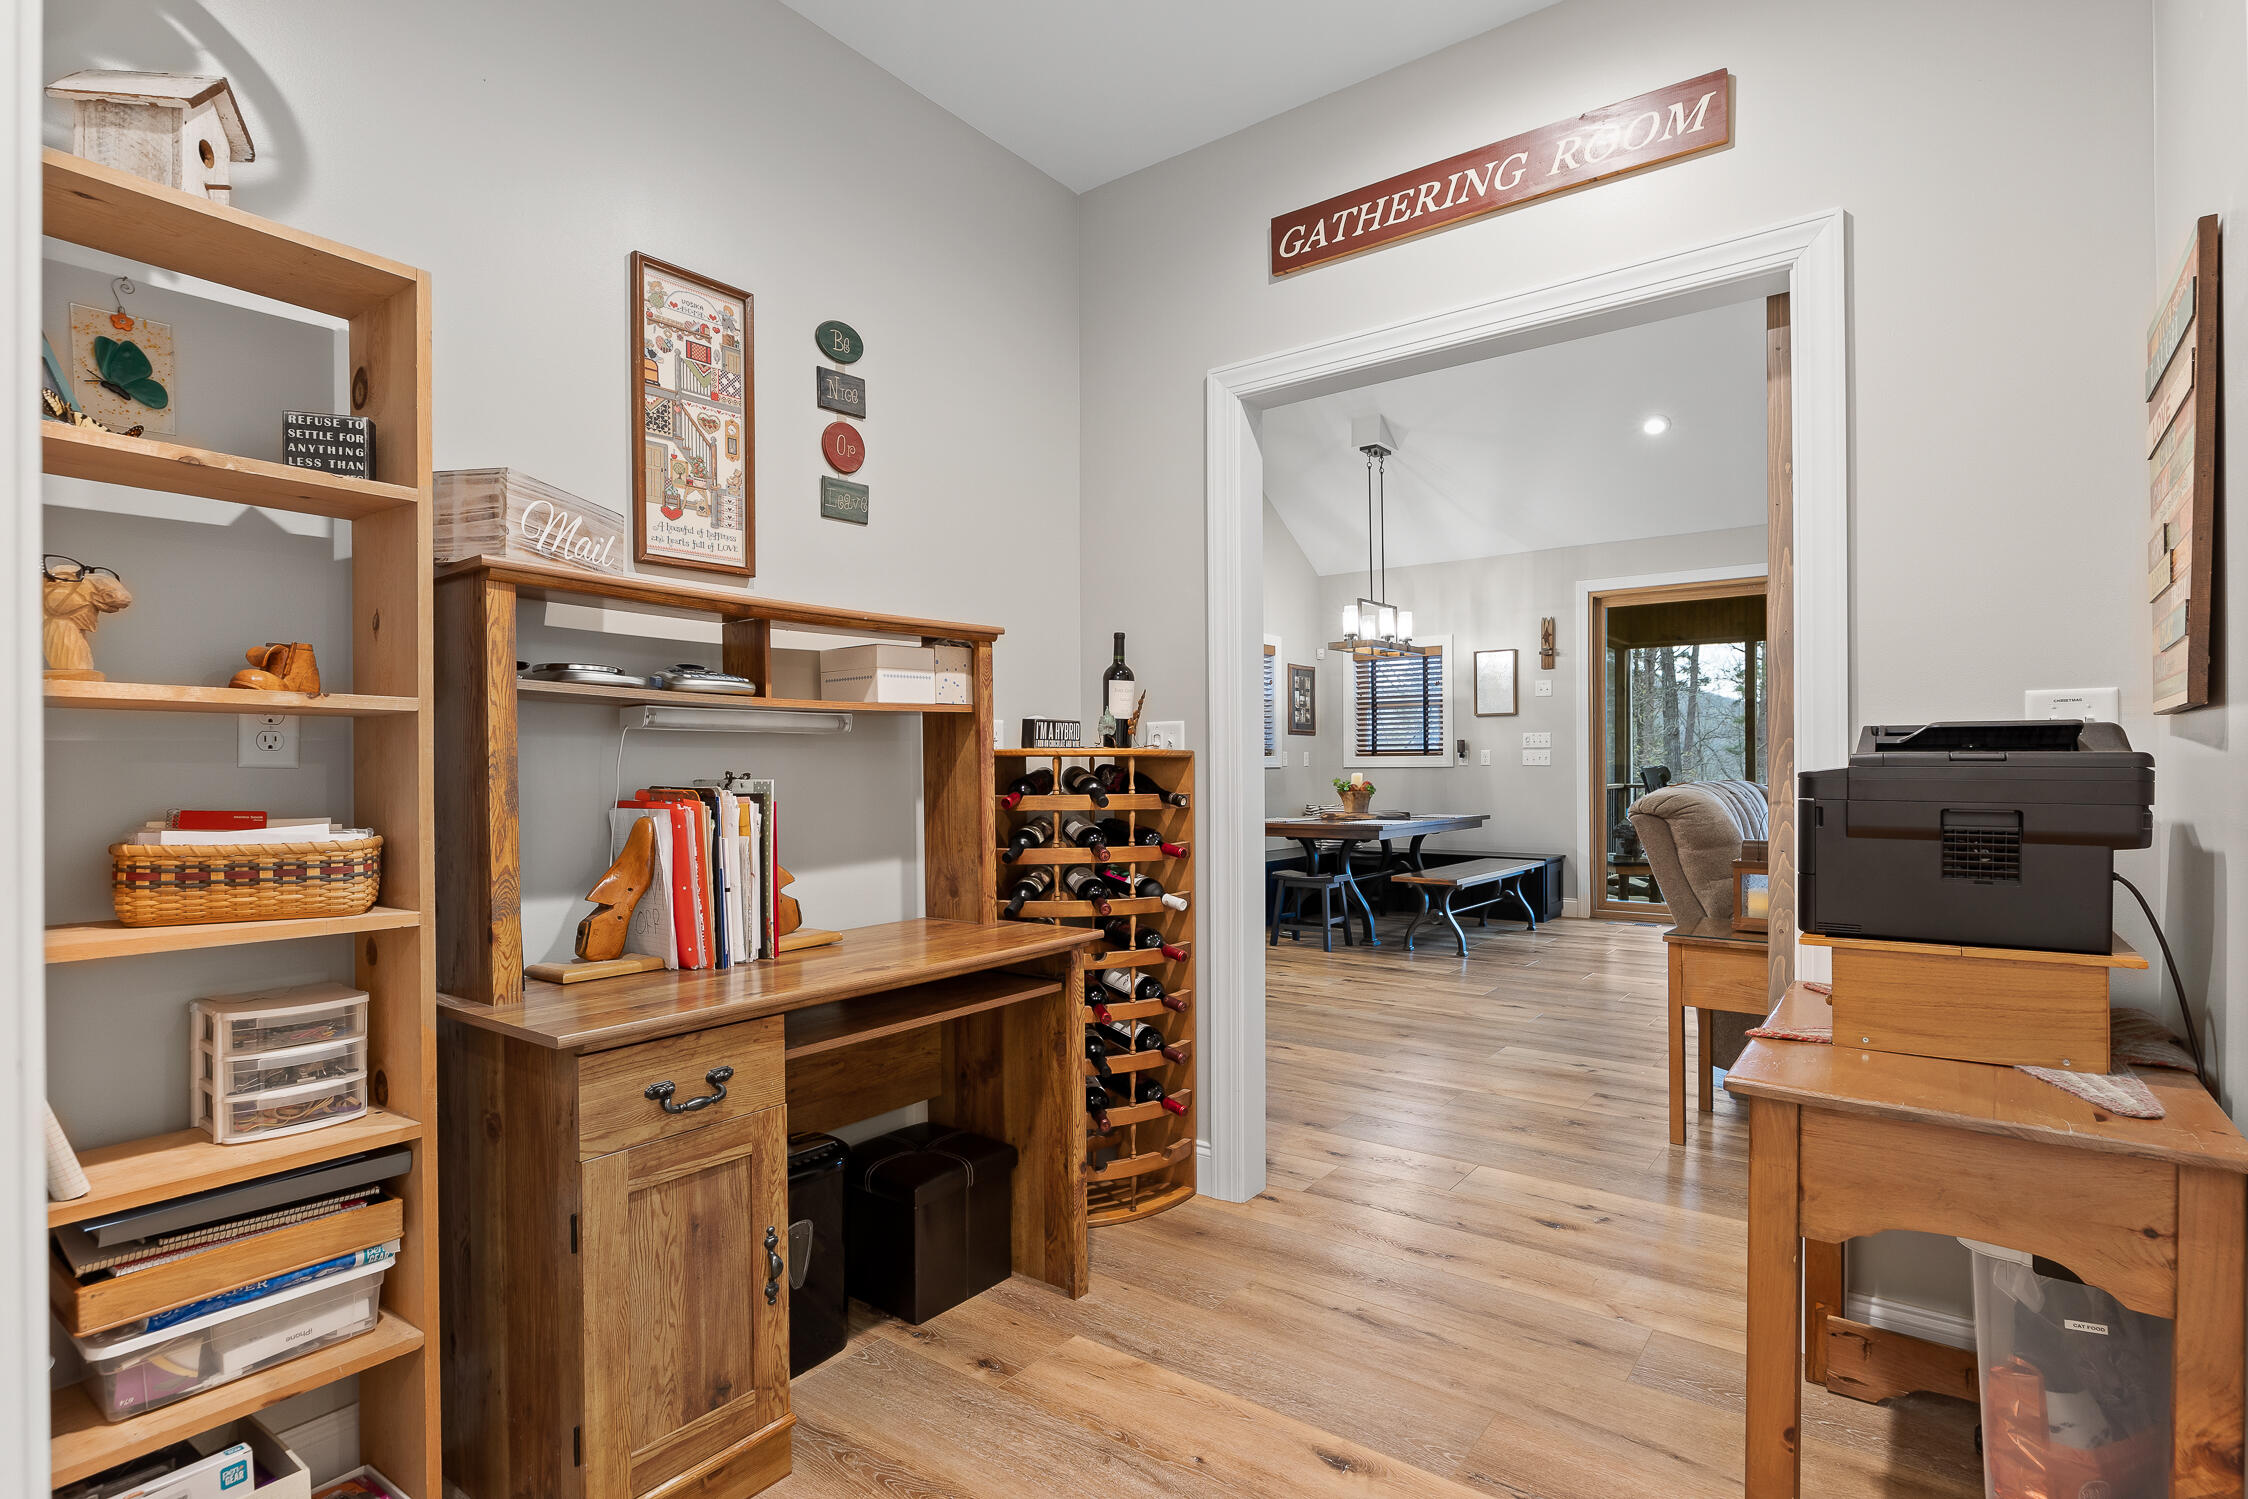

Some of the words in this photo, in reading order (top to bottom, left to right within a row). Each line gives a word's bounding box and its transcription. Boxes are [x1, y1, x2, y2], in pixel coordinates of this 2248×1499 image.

[1279, 151, 1529, 258] GATHERING
[1546, 91, 1717, 176] ROOM
[830, 329, 850, 353] Be
[287, 414, 341, 428] REFUSE
[346, 419, 364, 430] TO
[2152, 392, 2171, 446] LOVE
[287, 428, 335, 441] SETTLE
[339, 432, 365, 444] FOR
[287, 442, 365, 457] ANYTHING
[836, 434, 856, 458] Or
[288, 456, 322, 468] LESS
[328, 459, 365, 471] THAN
[825, 487, 868, 512] Leave
[521, 500, 616, 567] Mail
[653, 521, 664, 532] A
[696, 528, 704, 538] of
[707, 529, 737, 542] happiness
[651, 535, 664, 543] and
[667, 535, 690, 548] hearts
[692, 538, 705, 550] full
[707, 542, 714, 553] of
[717, 543, 738, 553] LOVE
[1036, 721, 1048, 740] I'M
[1048, 722, 1054, 740] A
[1055, 722, 1080, 740] HYBRID
[285, 1327, 313, 1343] iPhone
[225, 1471, 244, 1486] GEAR
